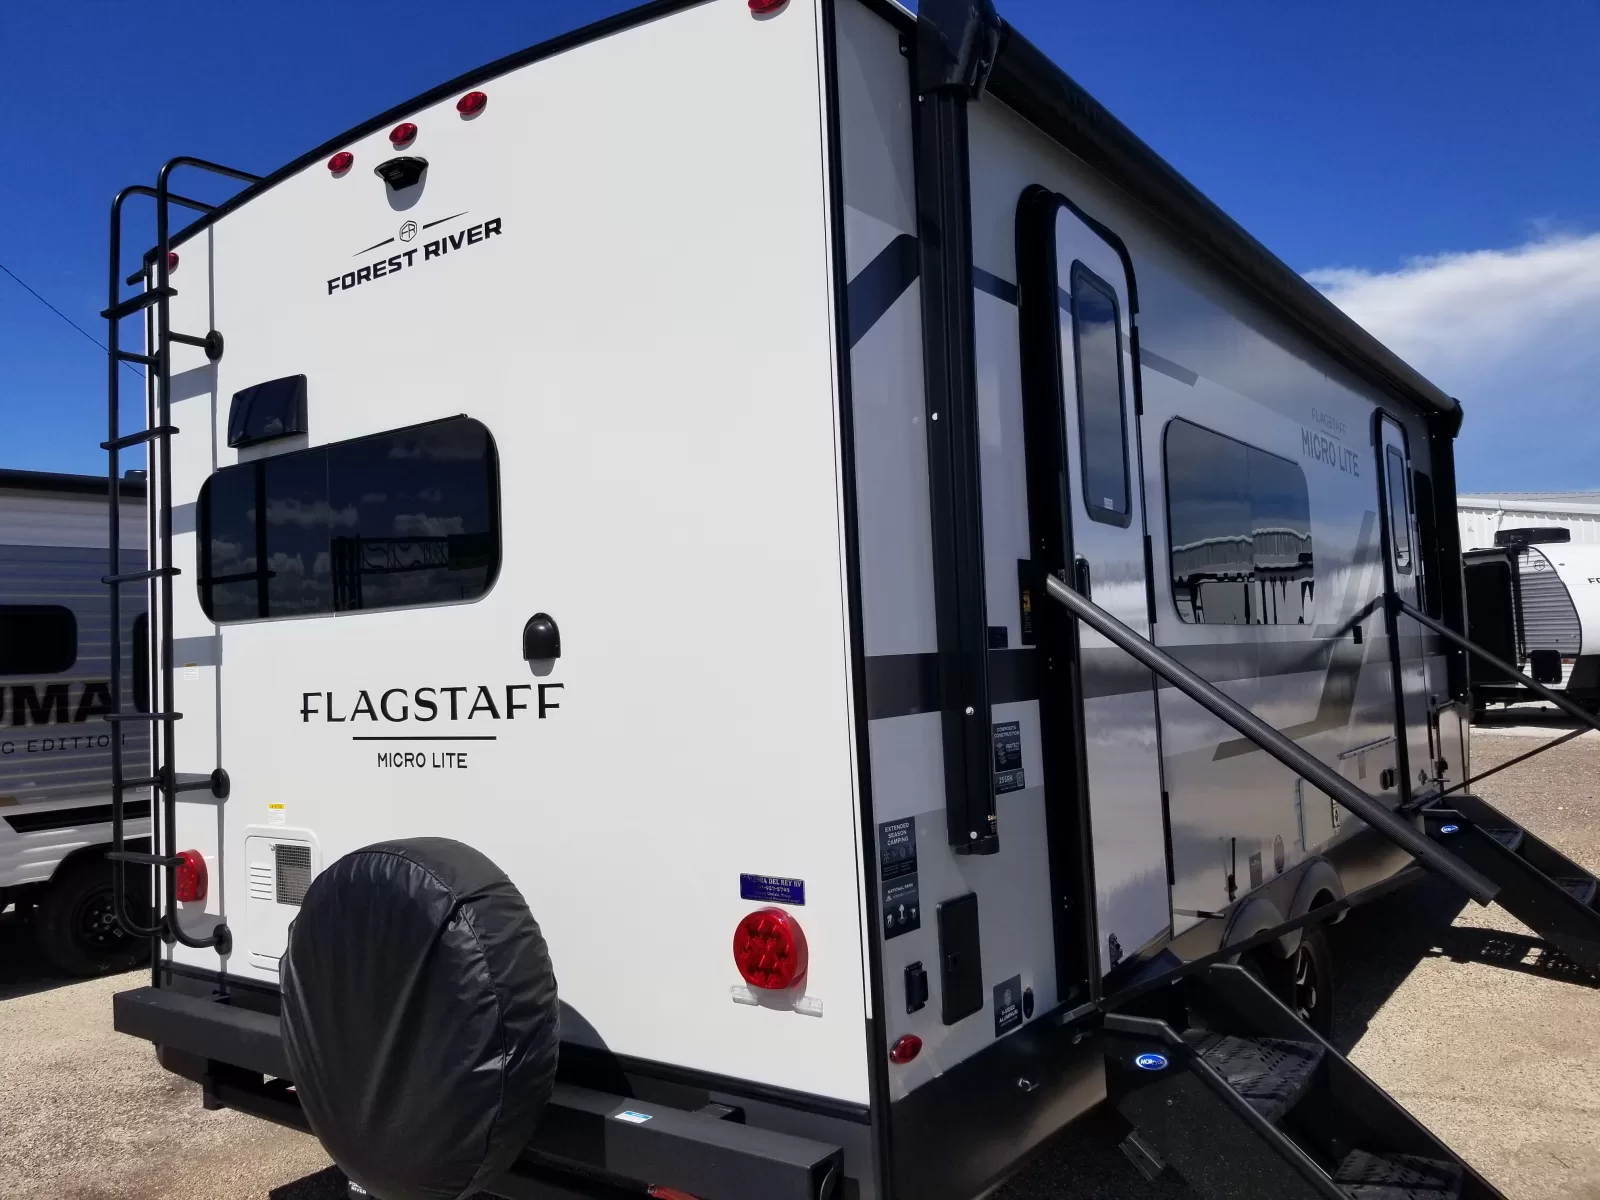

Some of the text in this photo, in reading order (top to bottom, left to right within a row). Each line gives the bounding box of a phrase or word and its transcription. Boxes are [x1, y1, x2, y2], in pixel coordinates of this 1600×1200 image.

[327, 217, 502, 295] FOREST RIVER
[1311, 407, 1347, 435] FLAGSTAFF
[1301, 427, 1360, 477] MICRO LITE
[300, 683, 565, 722] FLAGSTAFF
[27, 734, 126, 753] EDITIO
[377, 752, 468, 768] MICRO LITE
[884, 822, 909, 832] EXTENDED
[888, 830, 907, 838] SEASON
[887, 836, 909, 846] CAMPING
[768, 878, 780, 886] DEL
[780, 879, 792, 887] REY
[888, 885, 904, 894] NATIONAL
